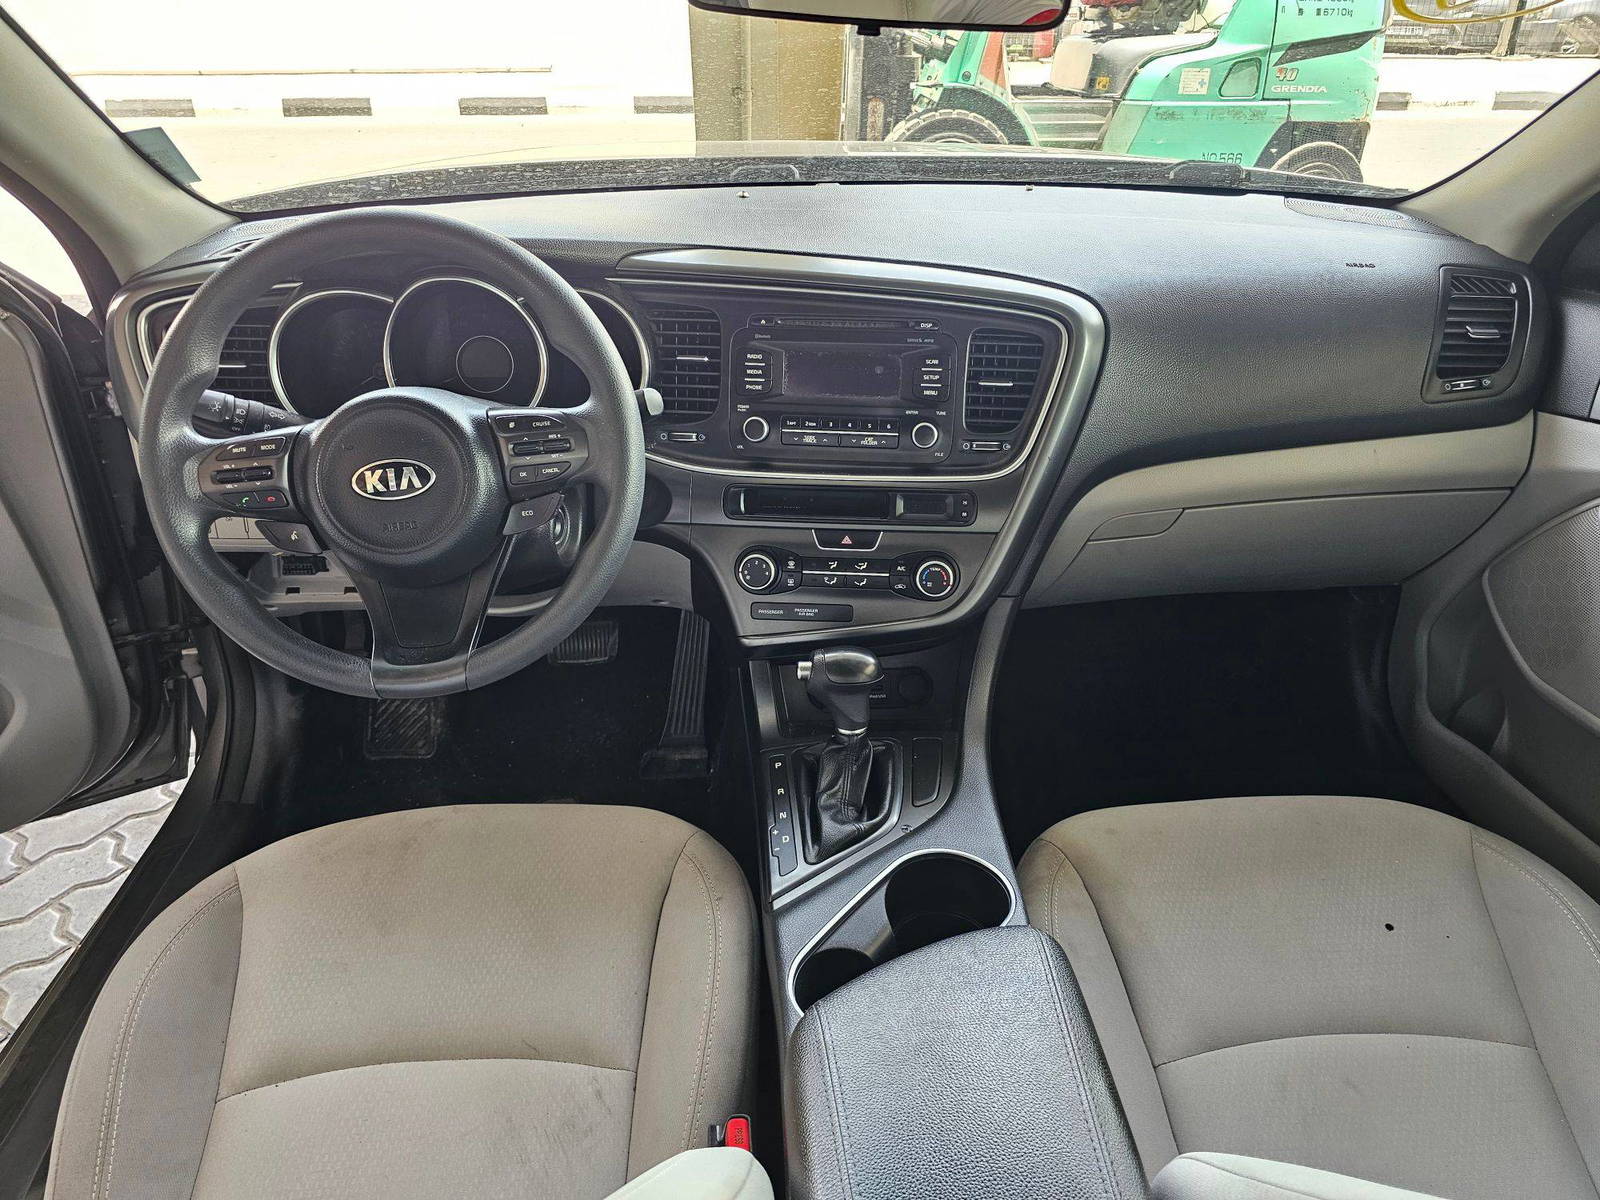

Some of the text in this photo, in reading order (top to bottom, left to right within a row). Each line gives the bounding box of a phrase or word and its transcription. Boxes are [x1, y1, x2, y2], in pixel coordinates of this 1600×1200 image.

[1271, 85, 1327, 93] GRENDIA
[363, 466, 423, 493] KIA
[782, 835, 790, 843] D
